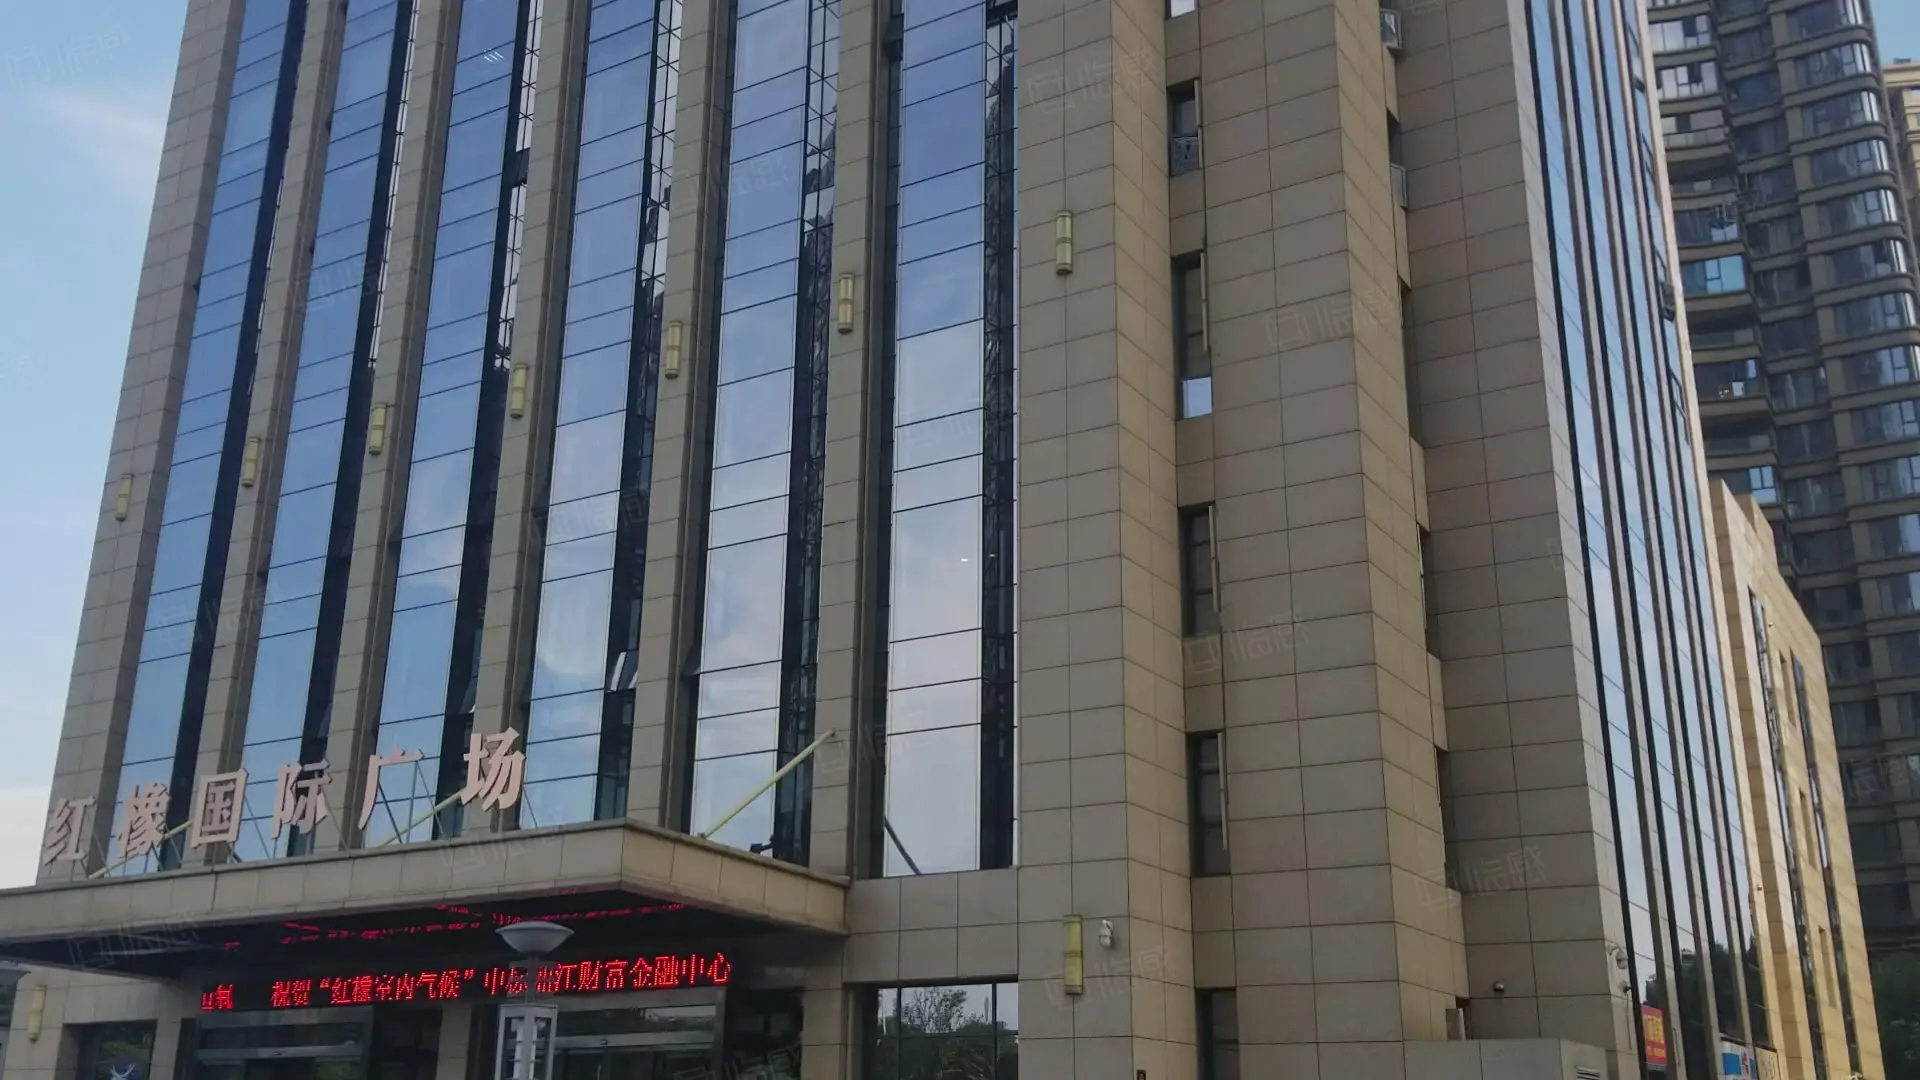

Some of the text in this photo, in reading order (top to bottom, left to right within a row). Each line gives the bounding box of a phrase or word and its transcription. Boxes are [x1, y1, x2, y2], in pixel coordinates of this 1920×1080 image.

[44, 726, 526, 864] 红橡国际广场
